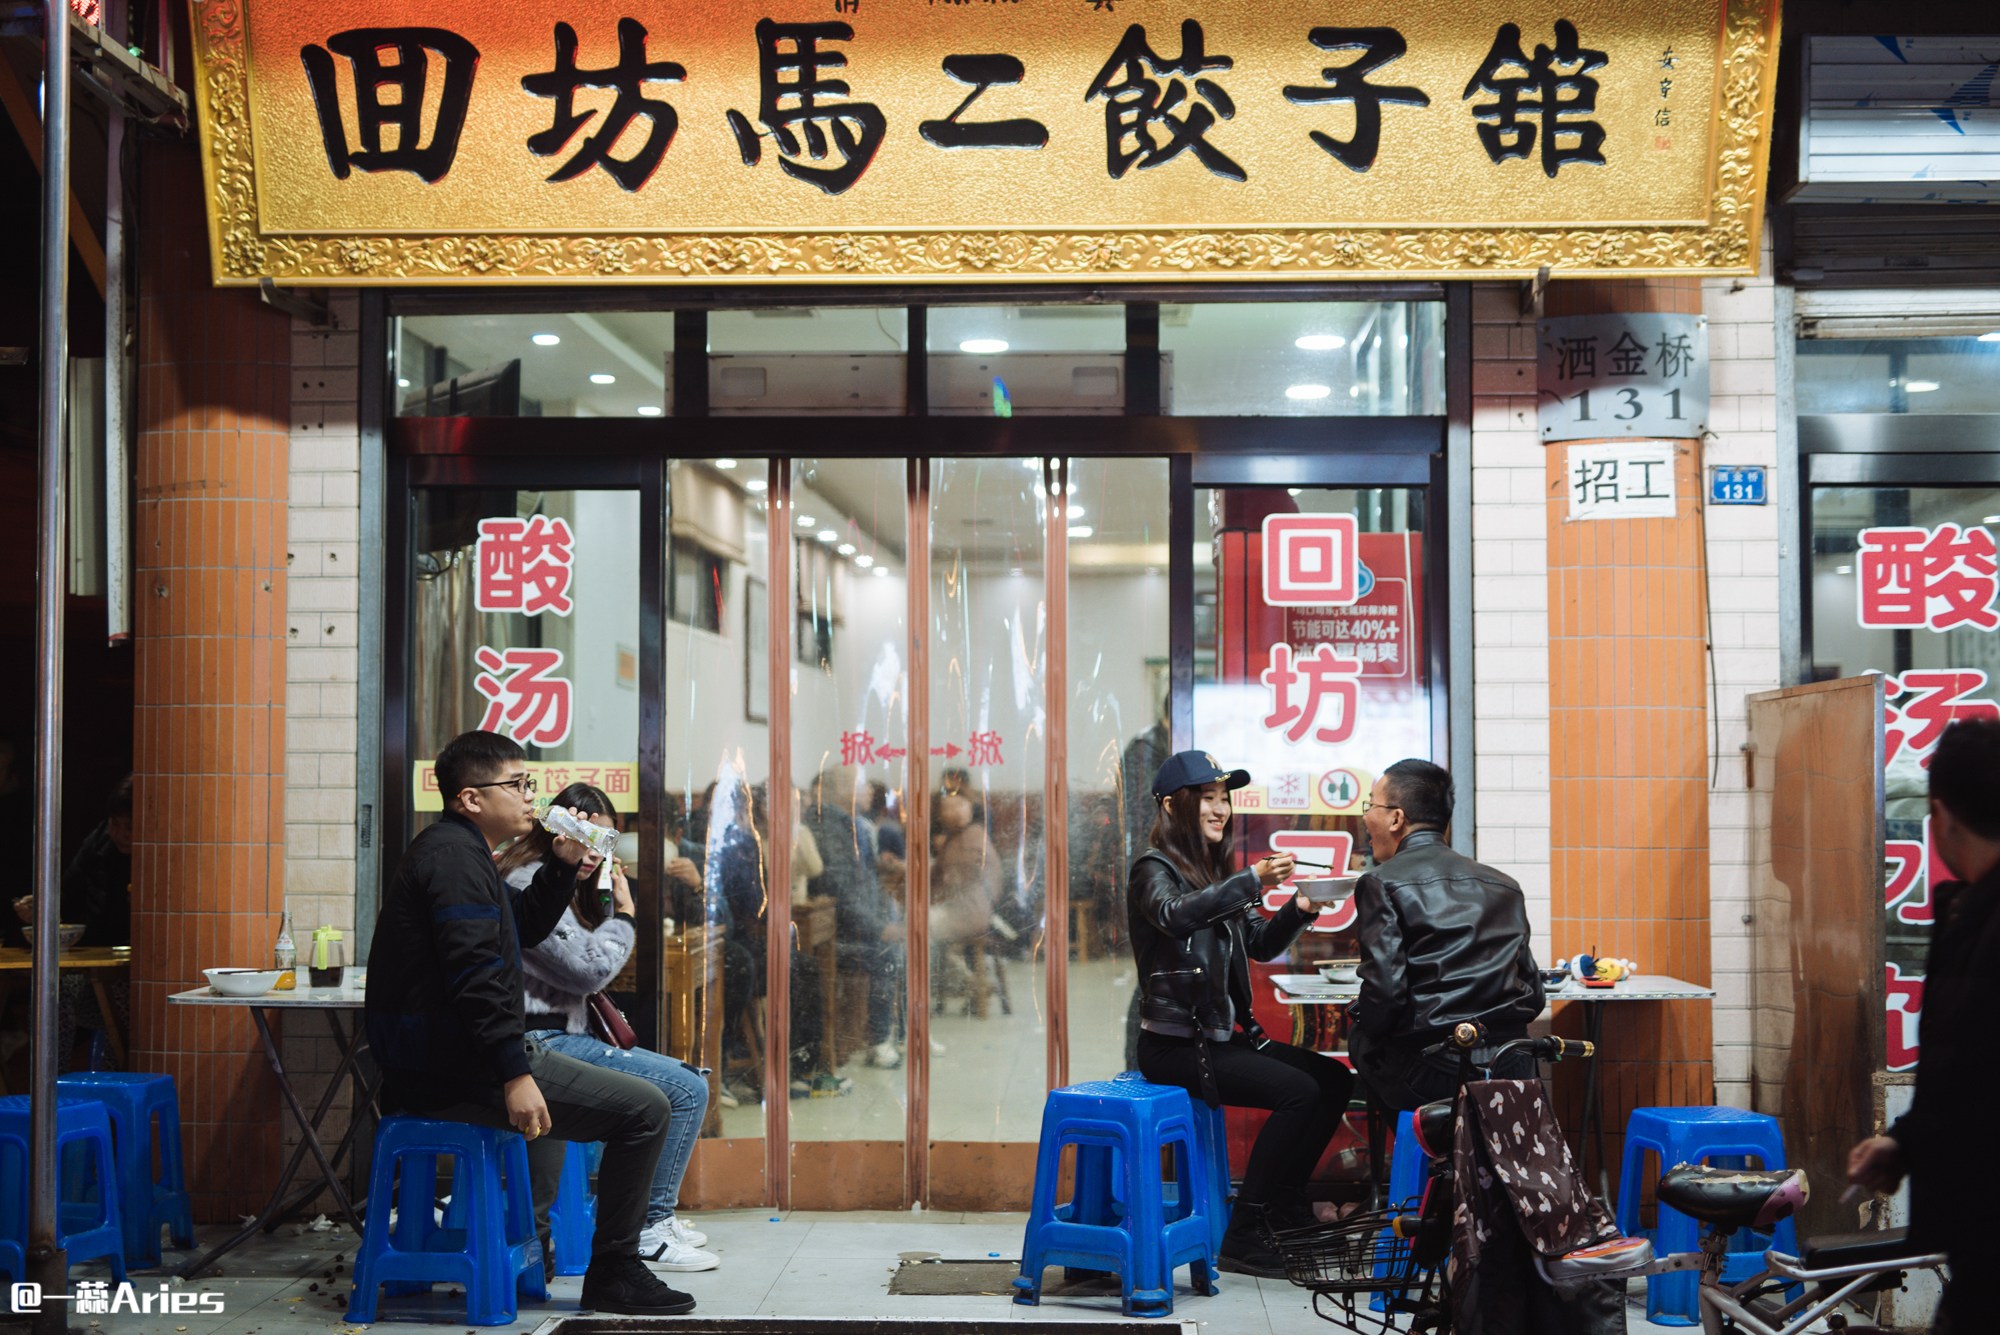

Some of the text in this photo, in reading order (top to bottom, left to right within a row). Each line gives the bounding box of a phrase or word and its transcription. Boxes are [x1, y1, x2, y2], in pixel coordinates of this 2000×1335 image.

[1557, 331, 1695, 381] 洒金桥
[1570, 387, 1688, 422] 131
[1574, 459, 1670, 504] 招工
[1722, 484, 1753, 499] 131
[475, 514, 574, 747] 酸汤
[1292, 620, 1400, 639] 节能可达40%+
[1294, 642, 1398, 663] 冰更畅爽
[840, 730, 876, 767] 掀
[967, 730, 1004, 767] 掀
